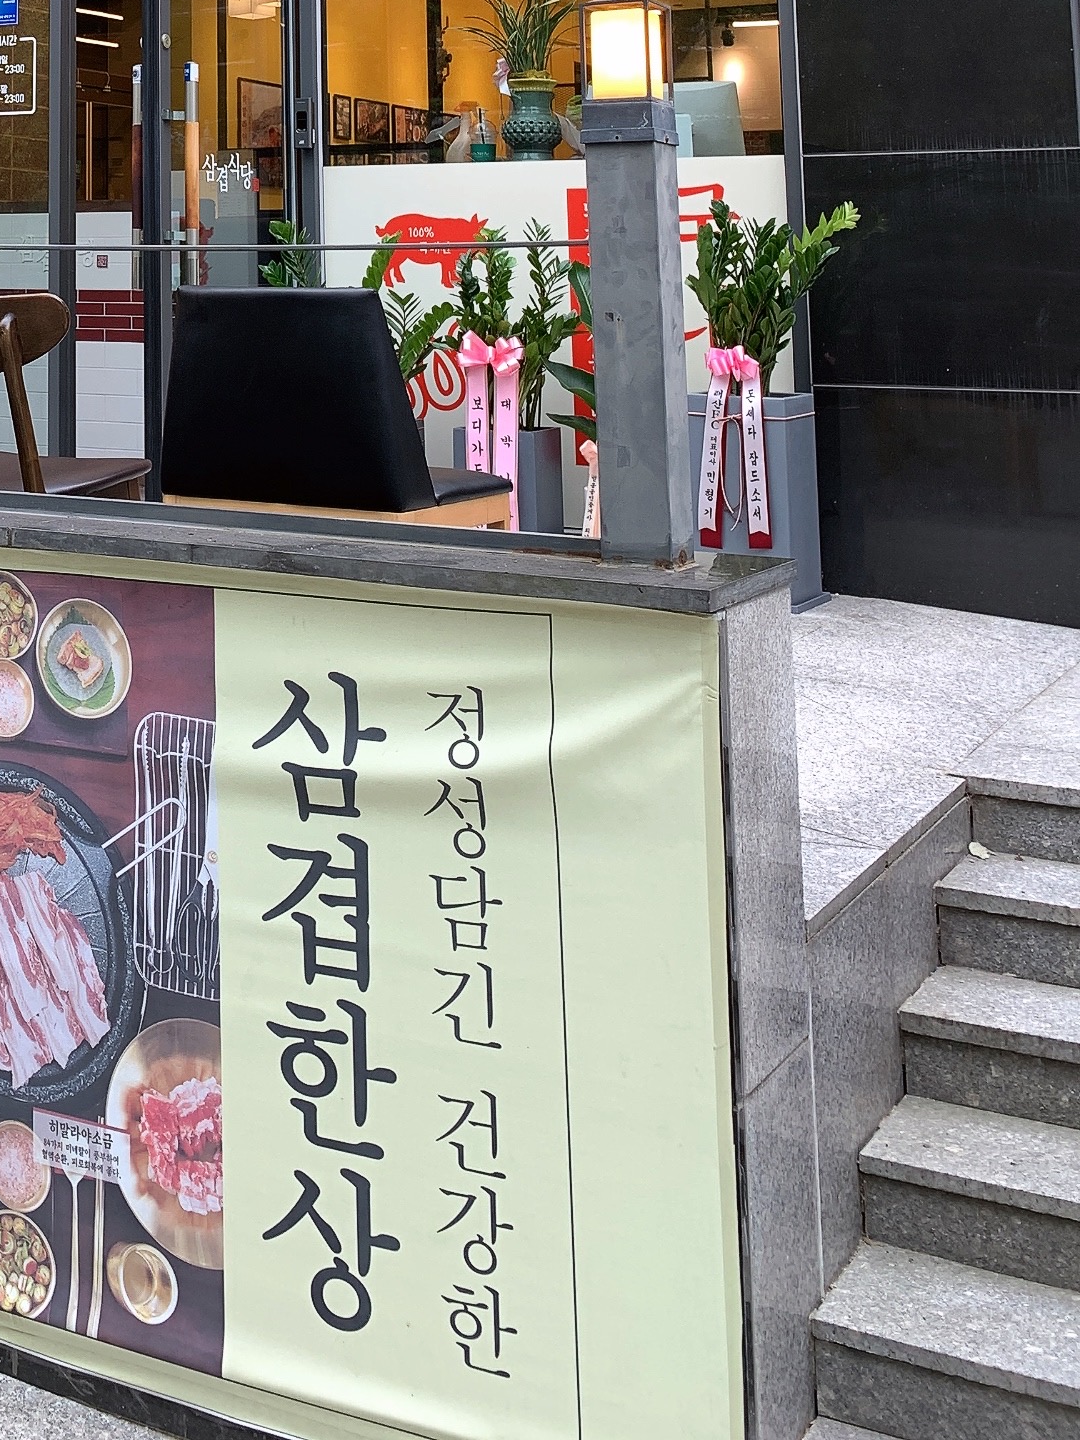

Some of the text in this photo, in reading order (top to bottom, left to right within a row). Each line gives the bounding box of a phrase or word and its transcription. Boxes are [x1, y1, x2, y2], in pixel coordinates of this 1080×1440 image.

[5, 63, 25, 74] 23:00
[4, 93, 25, 104] 23:00
[202, 152, 253, 192] 삼겹식당
[408, 226, 435, 238] 100%
[746, 389, 762, 520] 돈세다 잠드소서
[252, 671, 401, 1333] 삼겹한상
[423, 685, 517, 1380] 정성담긴 건강한
[48, 1119, 114, 1150] 히말라야소금
